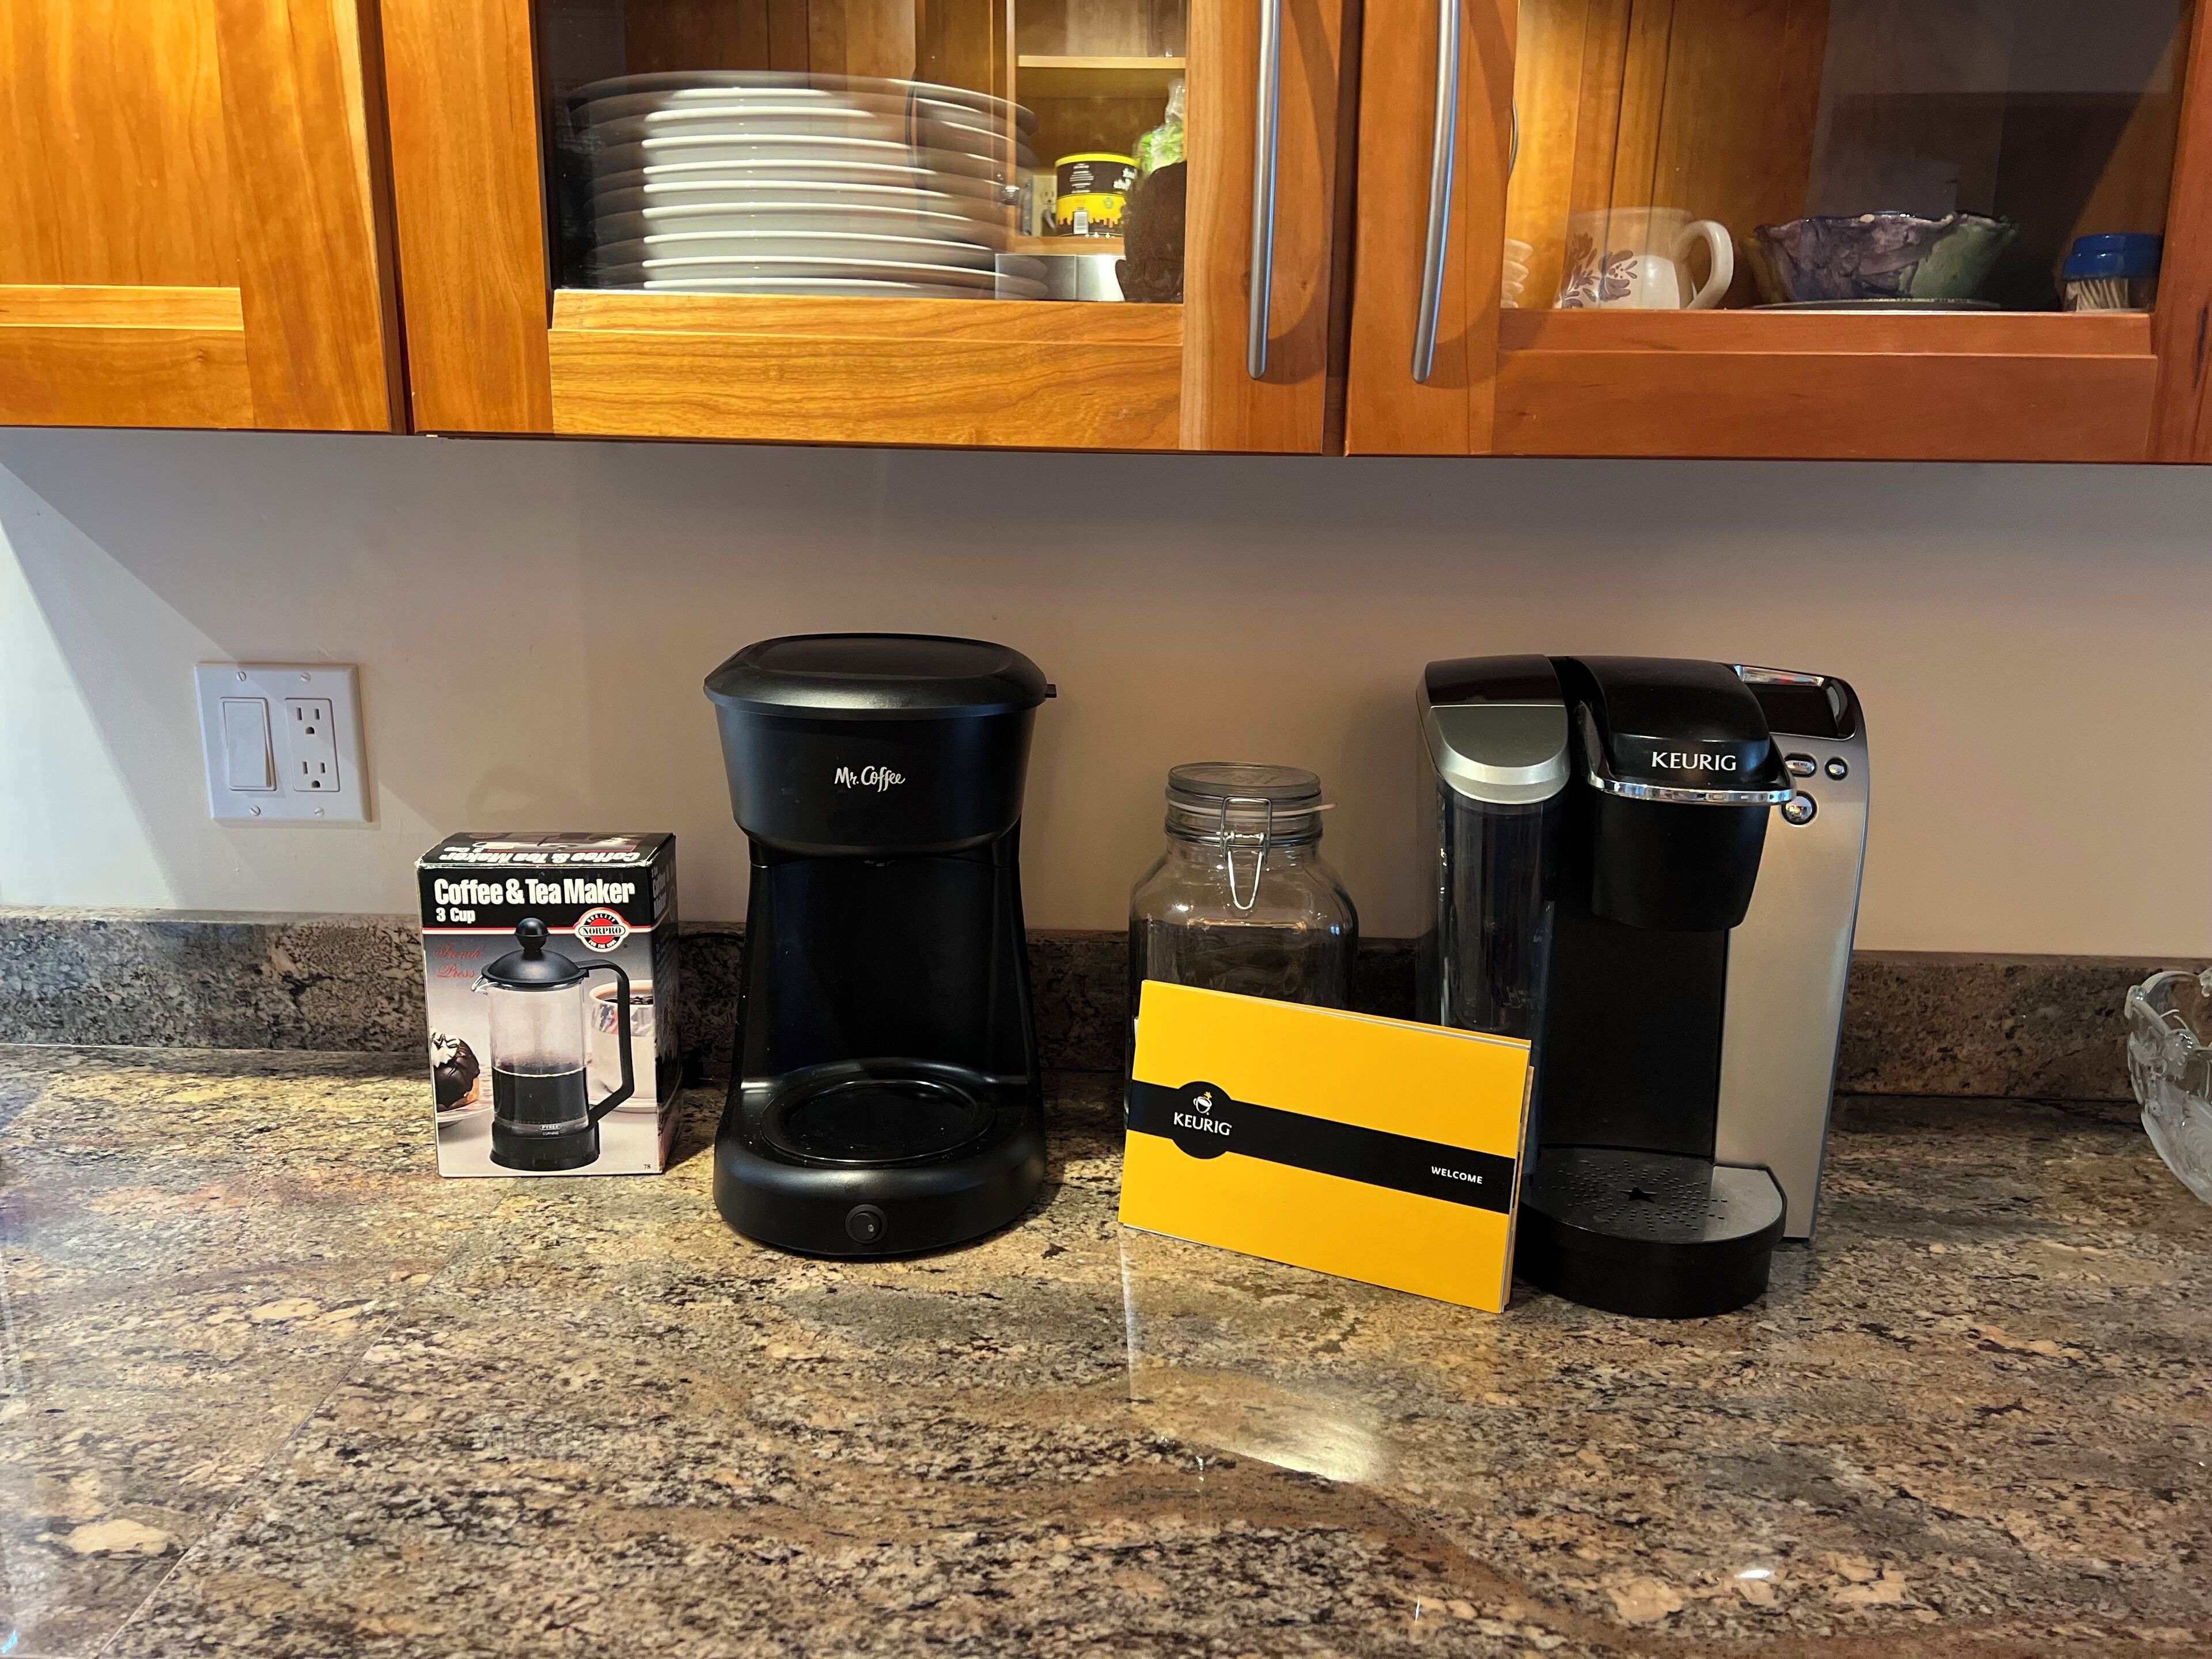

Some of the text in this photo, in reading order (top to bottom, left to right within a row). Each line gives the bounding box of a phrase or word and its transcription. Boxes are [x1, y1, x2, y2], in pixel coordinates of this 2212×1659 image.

[1652, 751, 1737, 771] KEURIG
[834, 766, 906, 793] Mr. Coffee
[439, 852, 641, 863] Coffee & Tea Maker
[434, 878, 504, 905] Coffee
[505, 878, 525, 904] &
[525, 878, 562, 904] Tea
[563, 878, 635, 904] Maker
[435, 907, 476, 924] 3 Cup
[586, 914, 616, 923] QUALITY
[582, 927, 622, 935] NORPRO
[434, 942, 484, 959] French
[437, 963, 475, 978] Press
[1173, 1112, 1232, 1136] KEURIG
[1431, 1166, 1483, 1184] WELCOME
